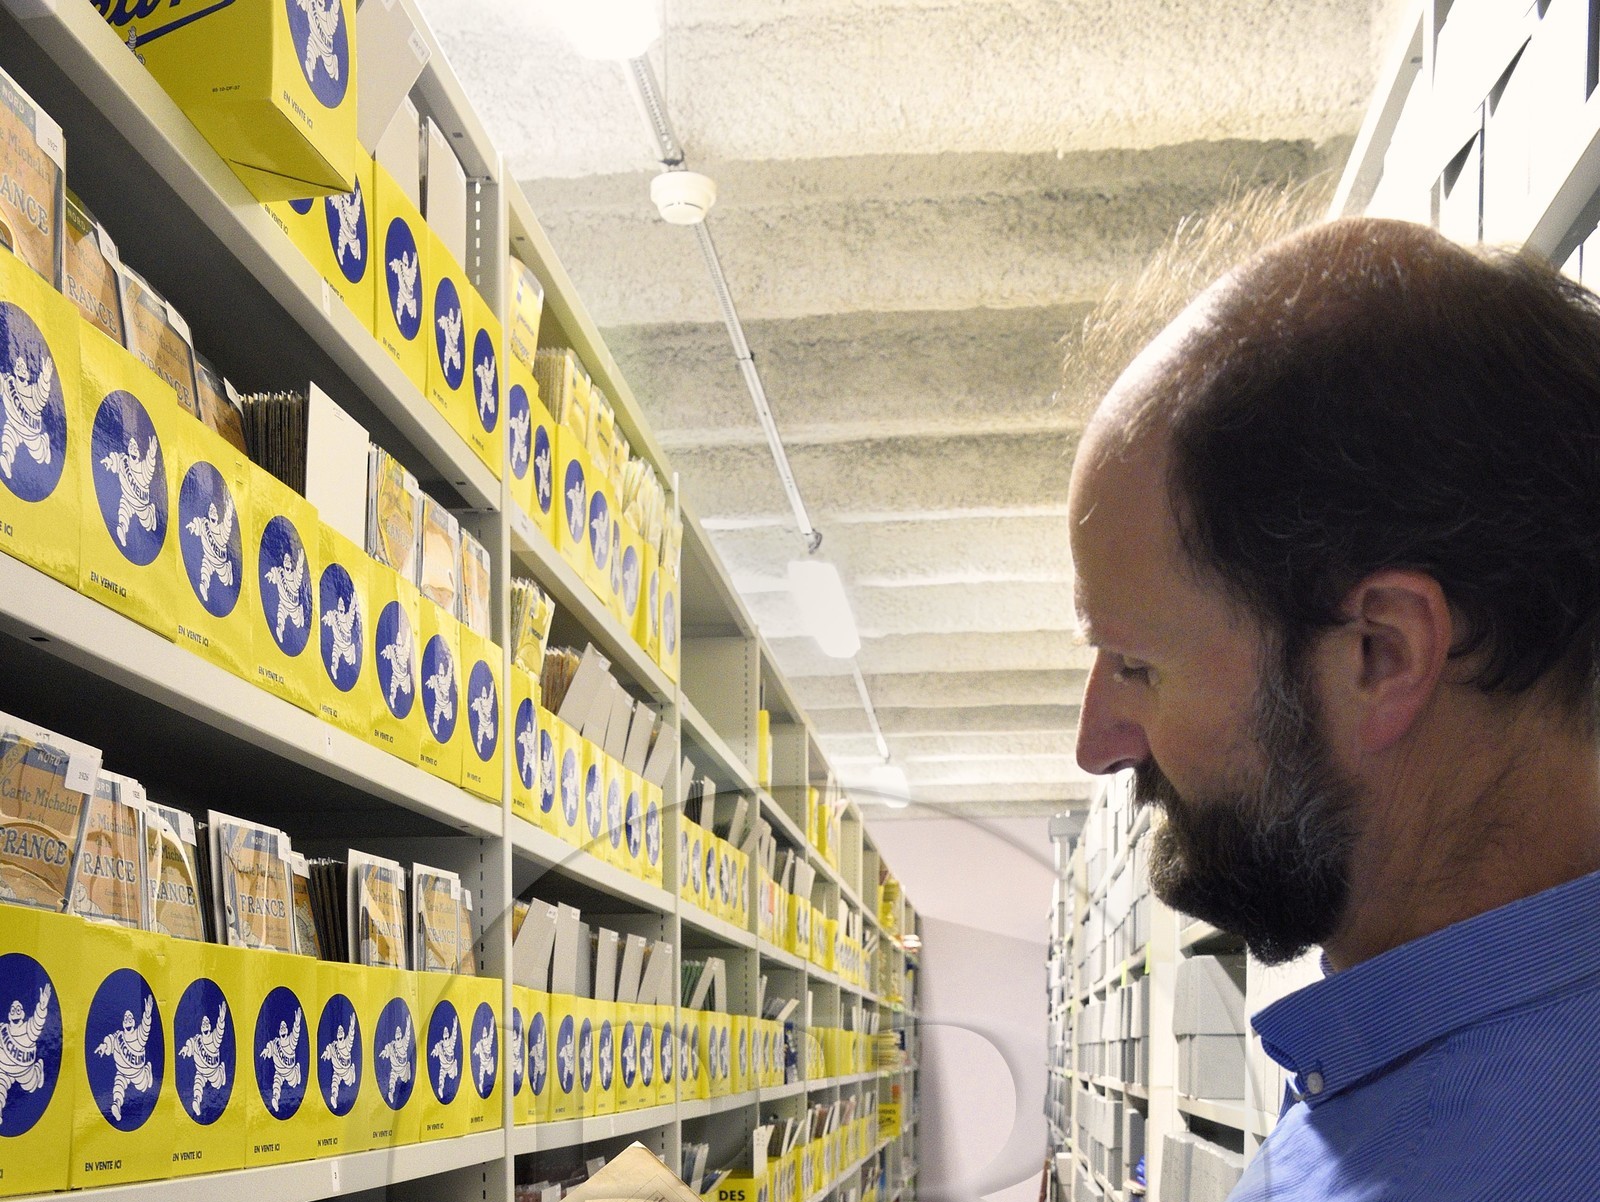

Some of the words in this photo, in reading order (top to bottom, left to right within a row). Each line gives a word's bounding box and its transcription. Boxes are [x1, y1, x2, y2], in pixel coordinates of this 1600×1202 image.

[283, 90, 291, 104] EN
[291, 99, 306, 122] VENTE
[306, 117, 314, 130] ICI
[8, 377, 40, 430] MICHELIN
[123, 457, 150, 501] MICHELIN
[4, 523, 13, 537] ICI
[204, 520, 227, 559] MICHELIN
[90, 571, 99, 583] EN
[100, 576, 118, 595] VENTE
[118, 588, 127, 599] ICI
[178, 624, 186, 635] EN
[187, 629, 202, 644] VENTE
[37, 751, 61, 765] NORD
[2, 778, 31, 801] Carte
[36, 787, 77, 815] Michelin
[240, 894, 286, 919] FRANCE
[1, 1027, 35, 1061] MICHELIN
[118, 1031, 145, 1065] MICHELIN
[197, 1034, 220, 1066] MICHELIN
[181, 1152, 195, 1160] VENTE
[261, 1144, 273, 1152] VENTE
[85, 1162, 93, 1171] EN
[95, 1160, 113, 1170] VENTE
[114, 1159, 122, 1169] ICI
[719, 1190, 745, 1201] DES
